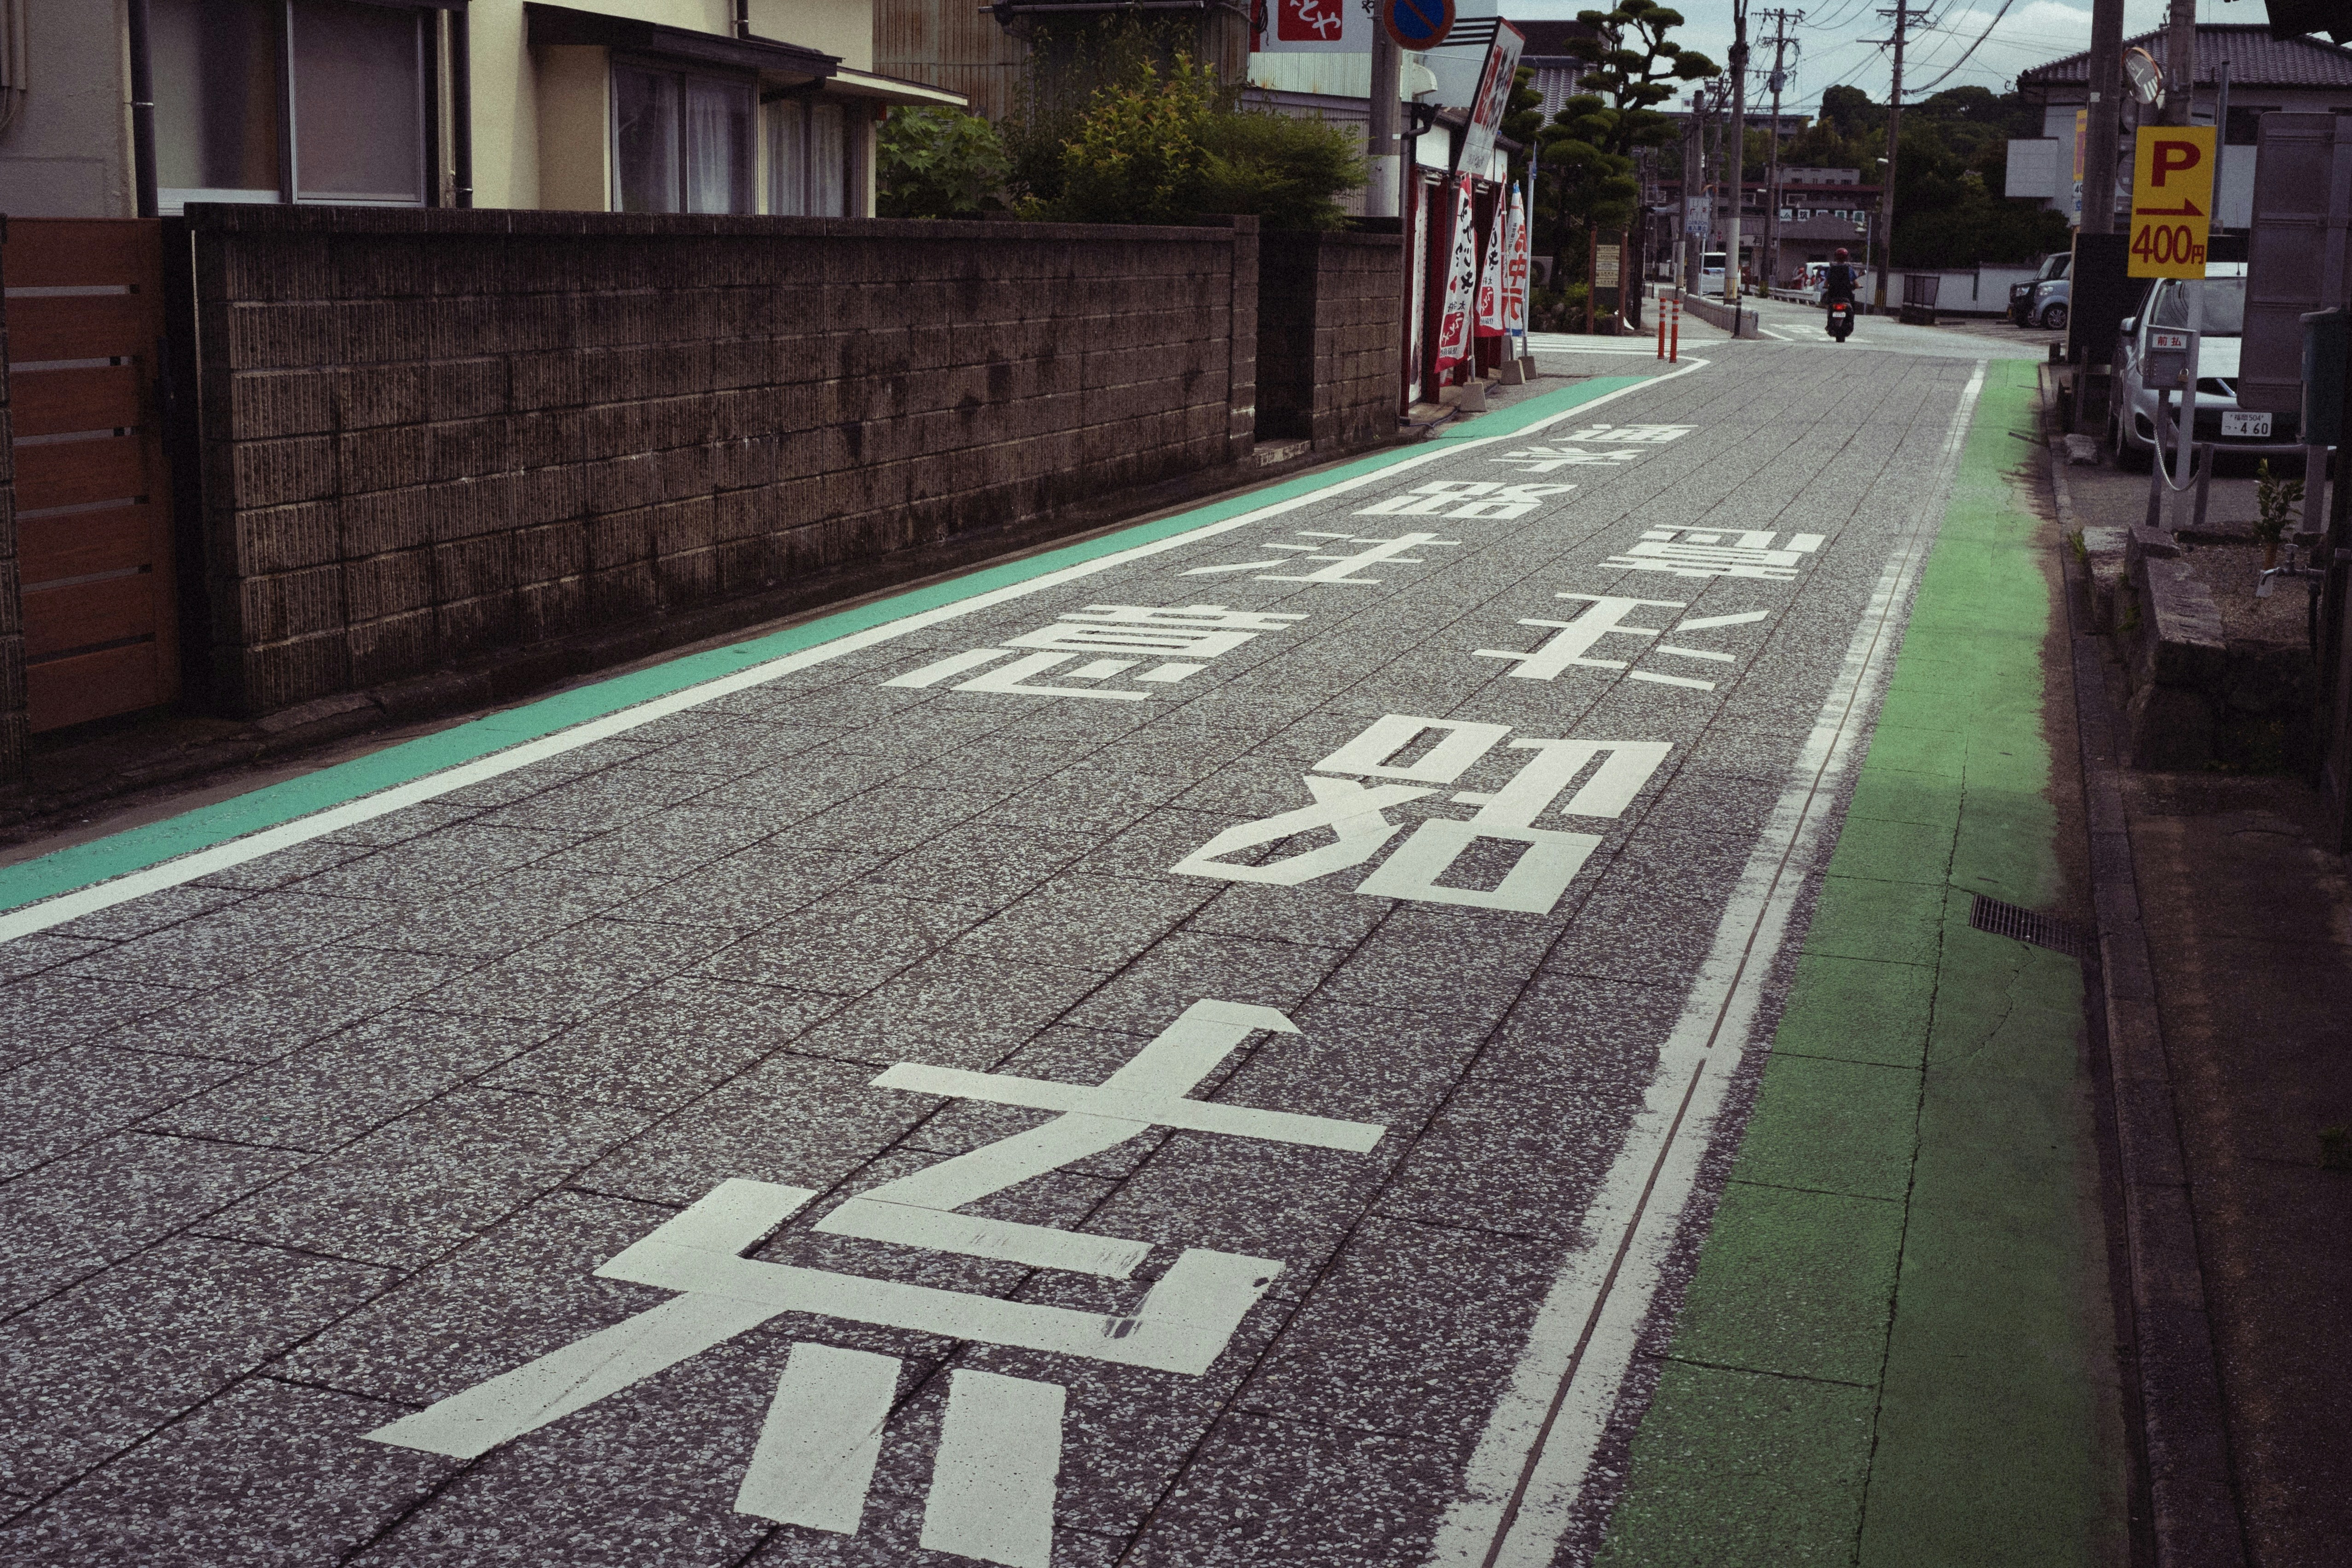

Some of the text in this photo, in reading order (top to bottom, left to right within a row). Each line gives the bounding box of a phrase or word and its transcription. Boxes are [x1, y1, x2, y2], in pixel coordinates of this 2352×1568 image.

[2151, 141, 2201, 187] P
[2131, 224, 2205, 265] 400円
[2158, 336, 2181, 346] 前払
